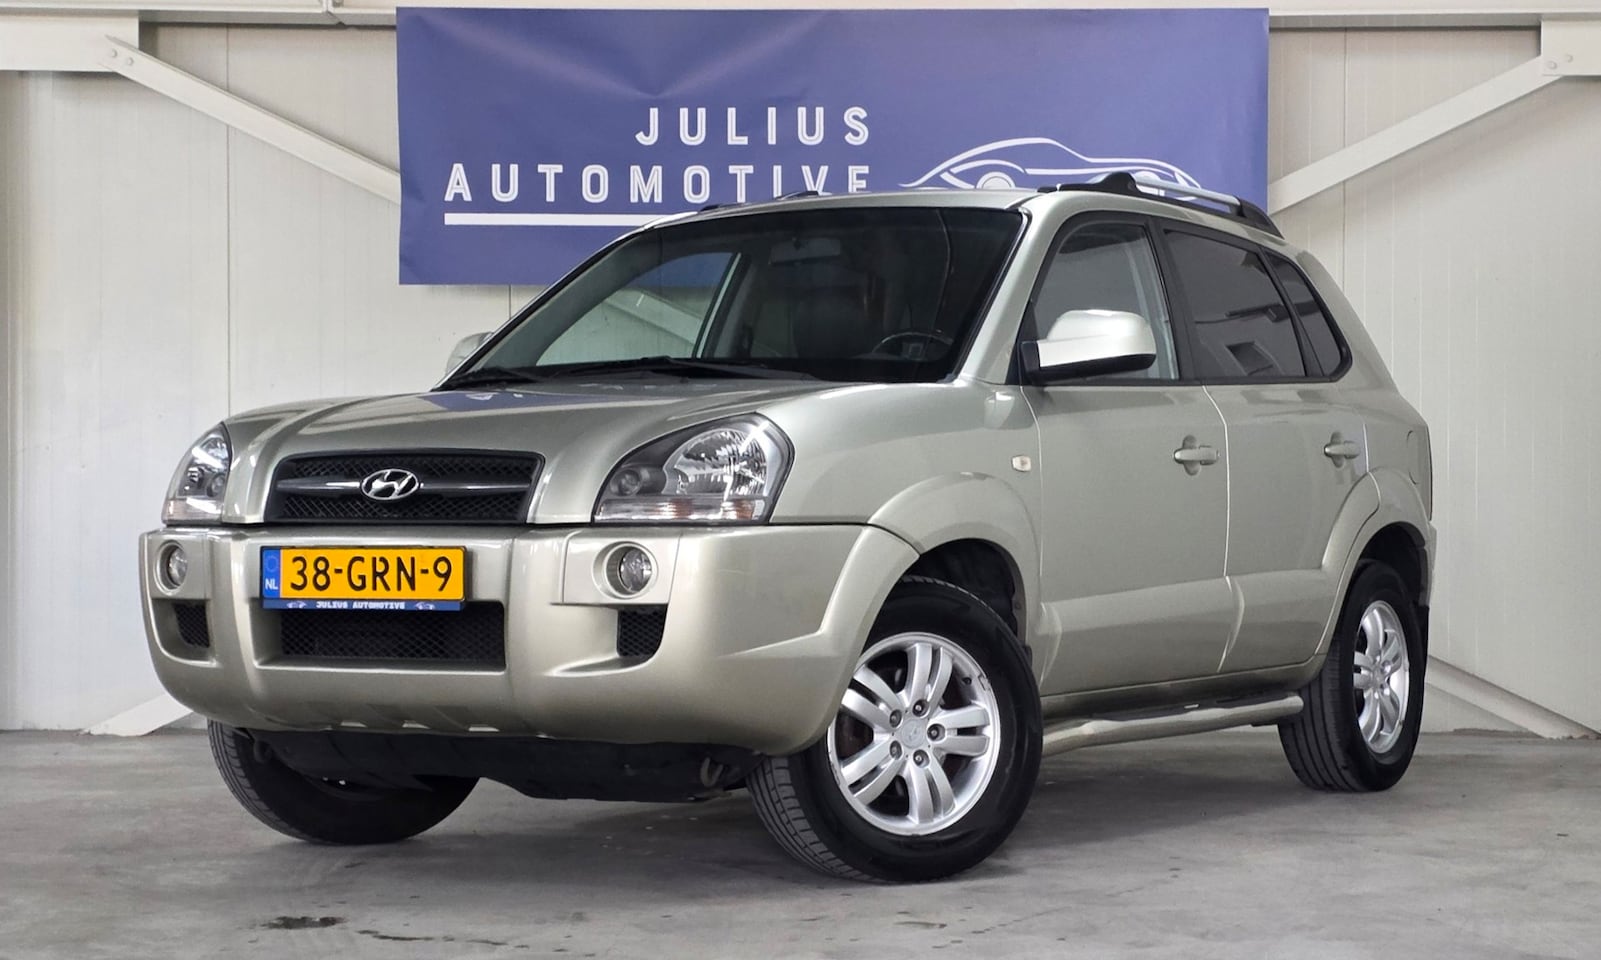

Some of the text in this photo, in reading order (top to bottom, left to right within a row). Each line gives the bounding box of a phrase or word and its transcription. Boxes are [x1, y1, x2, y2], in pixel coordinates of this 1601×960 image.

[635, 106, 870, 146] JULIUS
[444, 162, 870, 204] AUTOMOTIVE
[265, 578, 279, 590] NL
[290, 555, 452, 592] 38-GRN-9
[315, 600, 406, 610] JULIUS AUTOMOTIVE
